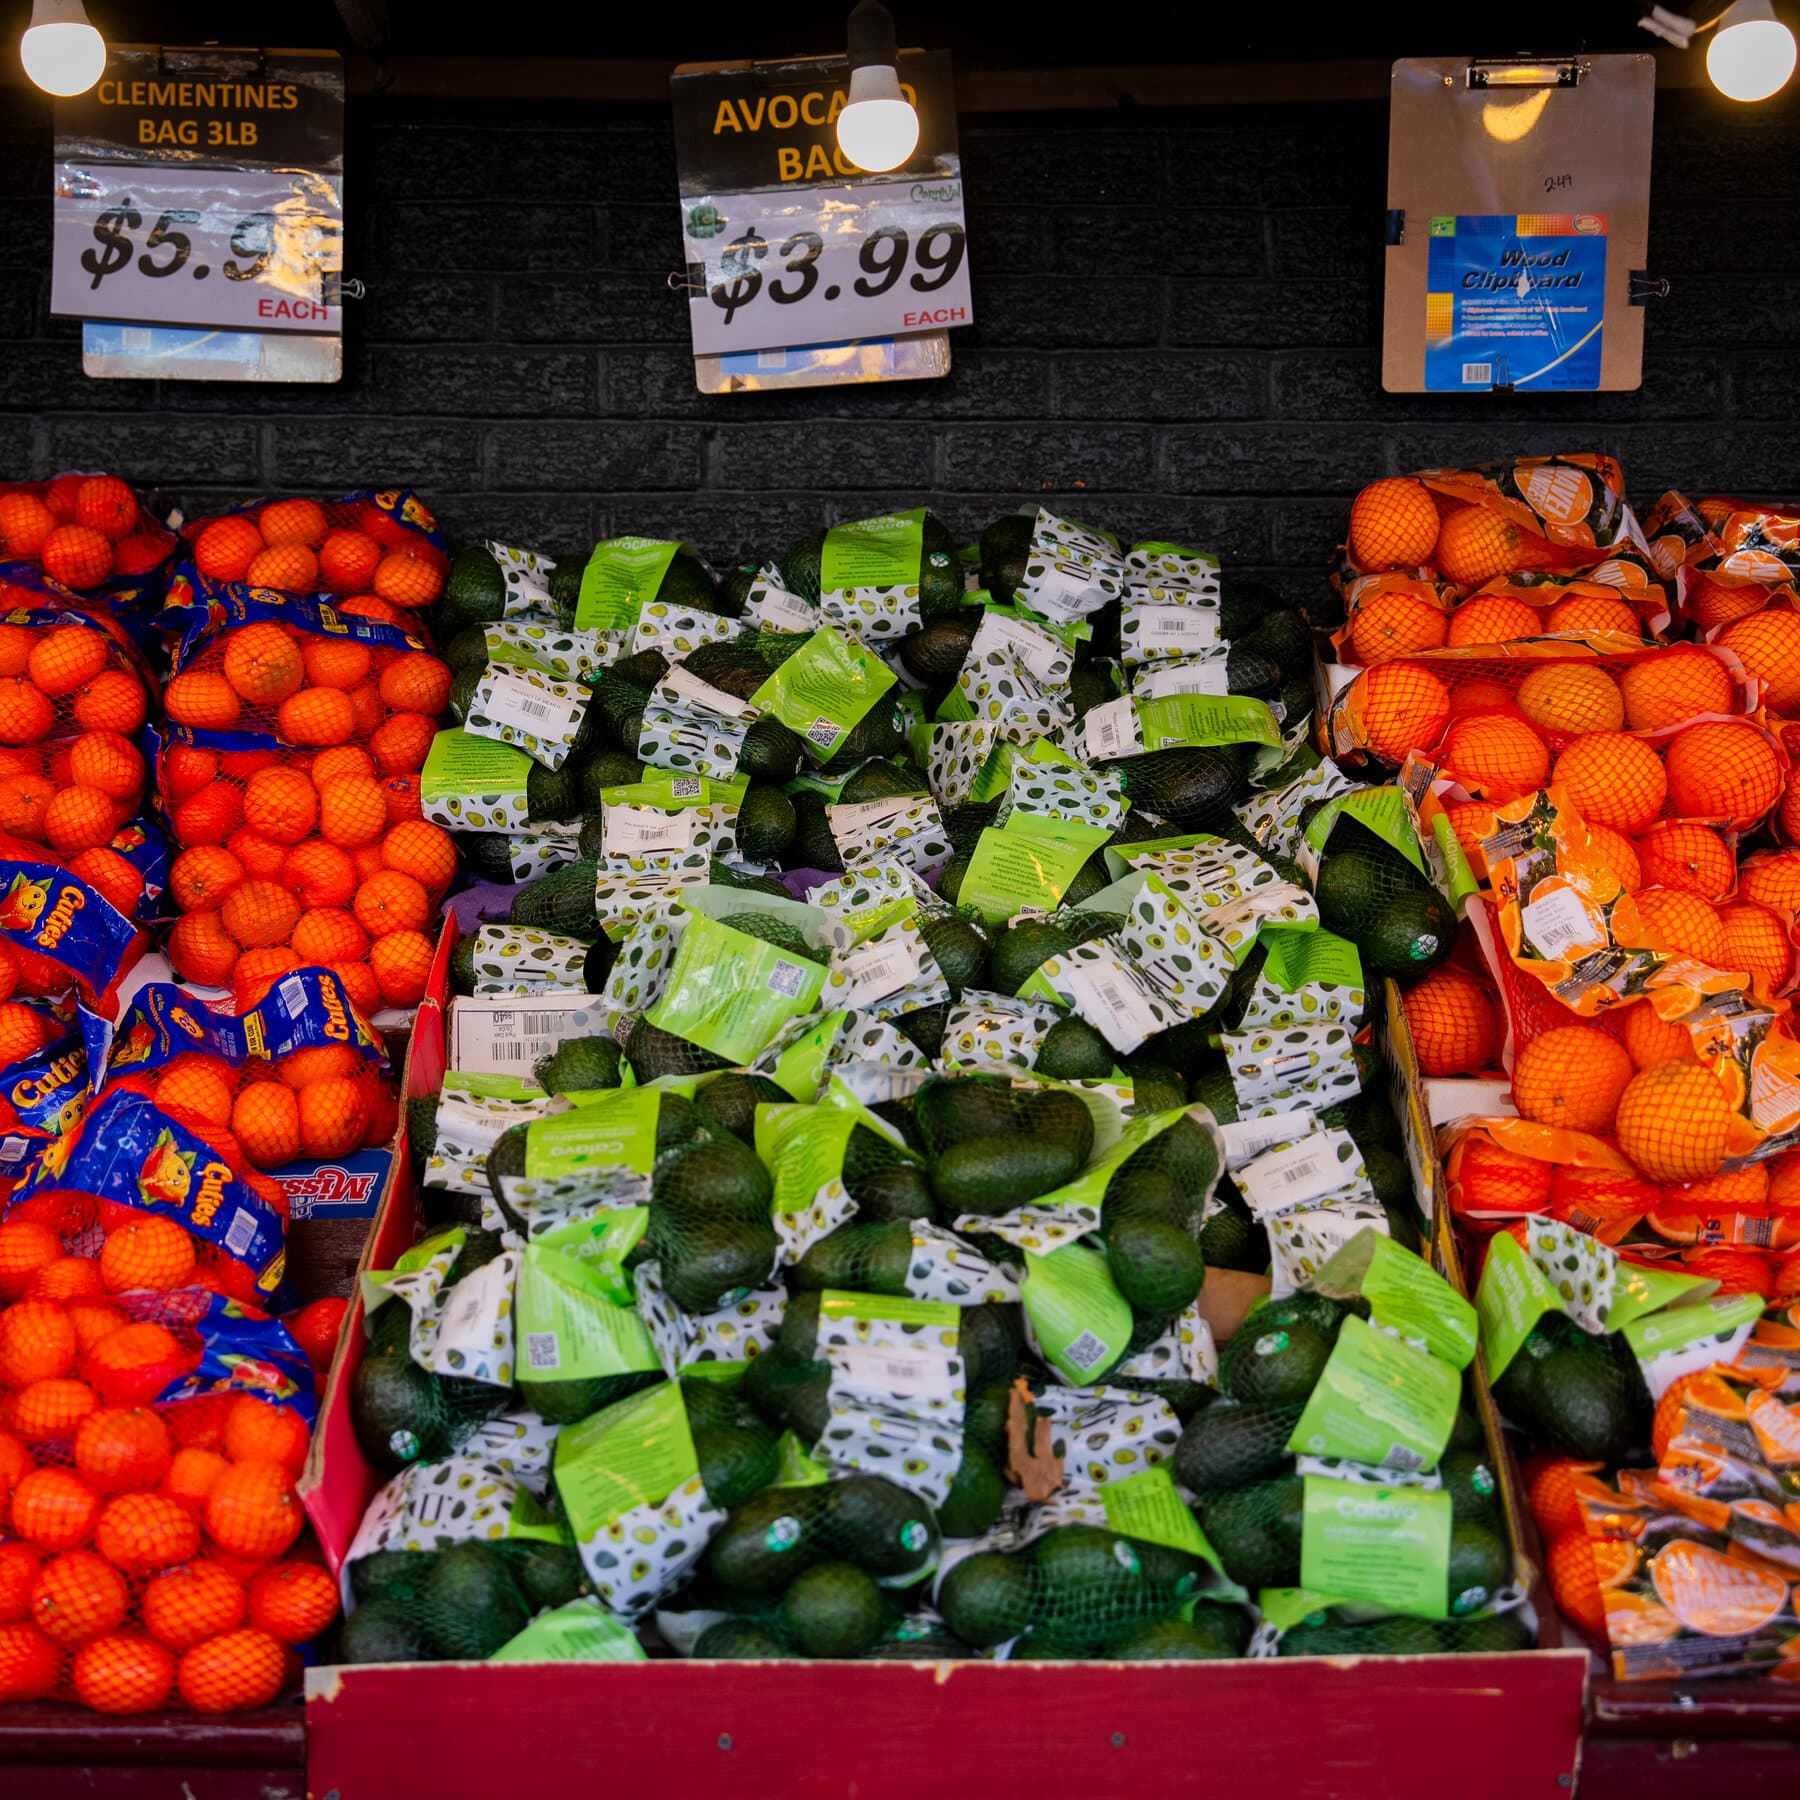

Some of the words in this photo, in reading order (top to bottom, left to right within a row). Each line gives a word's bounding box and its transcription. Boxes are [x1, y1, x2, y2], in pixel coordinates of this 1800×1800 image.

[97, 82, 298, 109] CLEMENTINES
[138, 119, 198, 144] BAG
[207, 121, 259, 145] 3LB
[1501, 249, 1571, 269] Wood
[711, 222, 966, 325] $3.99
[258, 299, 328, 320] EACH
[903, 307, 966, 326] EACH
[38, 885, 86, 950] Cuties
[322, 973, 350, 1042] Cuties
[550, 1140, 625, 1156] Calavo
[190, 1162, 233, 1227] Cuties
[1336, 1497, 1420, 1521] Calavo
